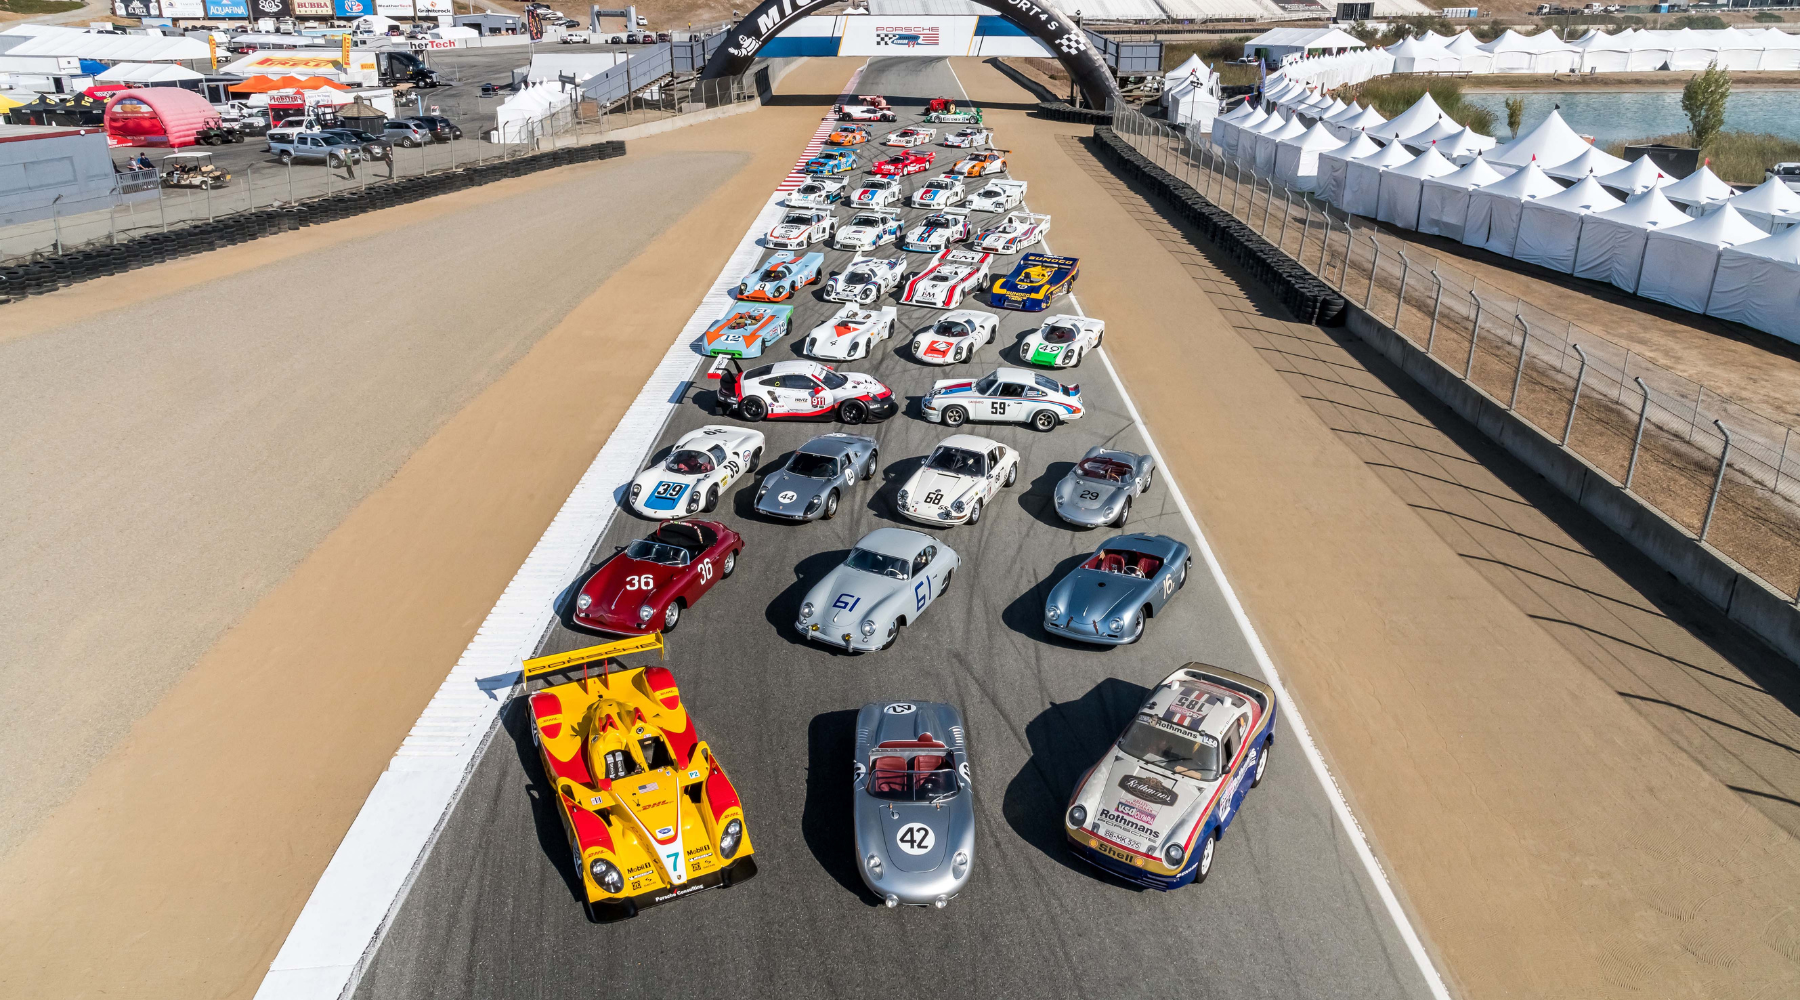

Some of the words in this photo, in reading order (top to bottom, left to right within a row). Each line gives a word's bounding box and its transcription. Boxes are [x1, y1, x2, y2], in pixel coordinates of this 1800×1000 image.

[210, 5, 246, 15] AQUAFINA
[259, 0, 282, 10] 805
[409, 39, 456, 49] herTech
[1028, 256, 1074, 265] SUNOCO
[842, 284, 857, 293] 22
[1006, 290, 1031, 298] SUNOCO
[723, 334, 741, 342] 12
[1039, 344, 1060, 353] 49
[812, 397, 826, 406] 911
[991, 401, 1006, 415] 59
[723, 460, 740, 479] 39
[656, 483, 684, 497] 39
[780, 493, 795, 501] 44
[1080, 489, 1100, 501] 29
[924, 491, 944, 506] 68
[697, 557, 713, 586] 36
[625, 574, 654, 591] 36
[1163, 573, 1173, 600] 16
[915, 574, 932, 613] 61
[832, 593, 861, 612] 61
[528, 641, 658, 673] PORSCHE
[886, 704, 912, 714] 42
[1175, 696, 1206, 713] 185
[1156, 719, 1198, 739] Rothmans
[1127, 778, 1172, 803] Rothmans
[642, 799, 669, 811] DHL
[1100, 808, 1160, 839] Rothmans
[899, 827, 930, 849] 42
[1127, 837, 1141, 850] 525
[687, 846, 704, 856] Mobil
[1098, 842, 1134, 864] Shell
[627, 863, 645, 874] Mobil
[666, 851, 680, 872] 7
[655, 892, 677, 902] Porsche
[676, 883, 705, 896] Consulting
